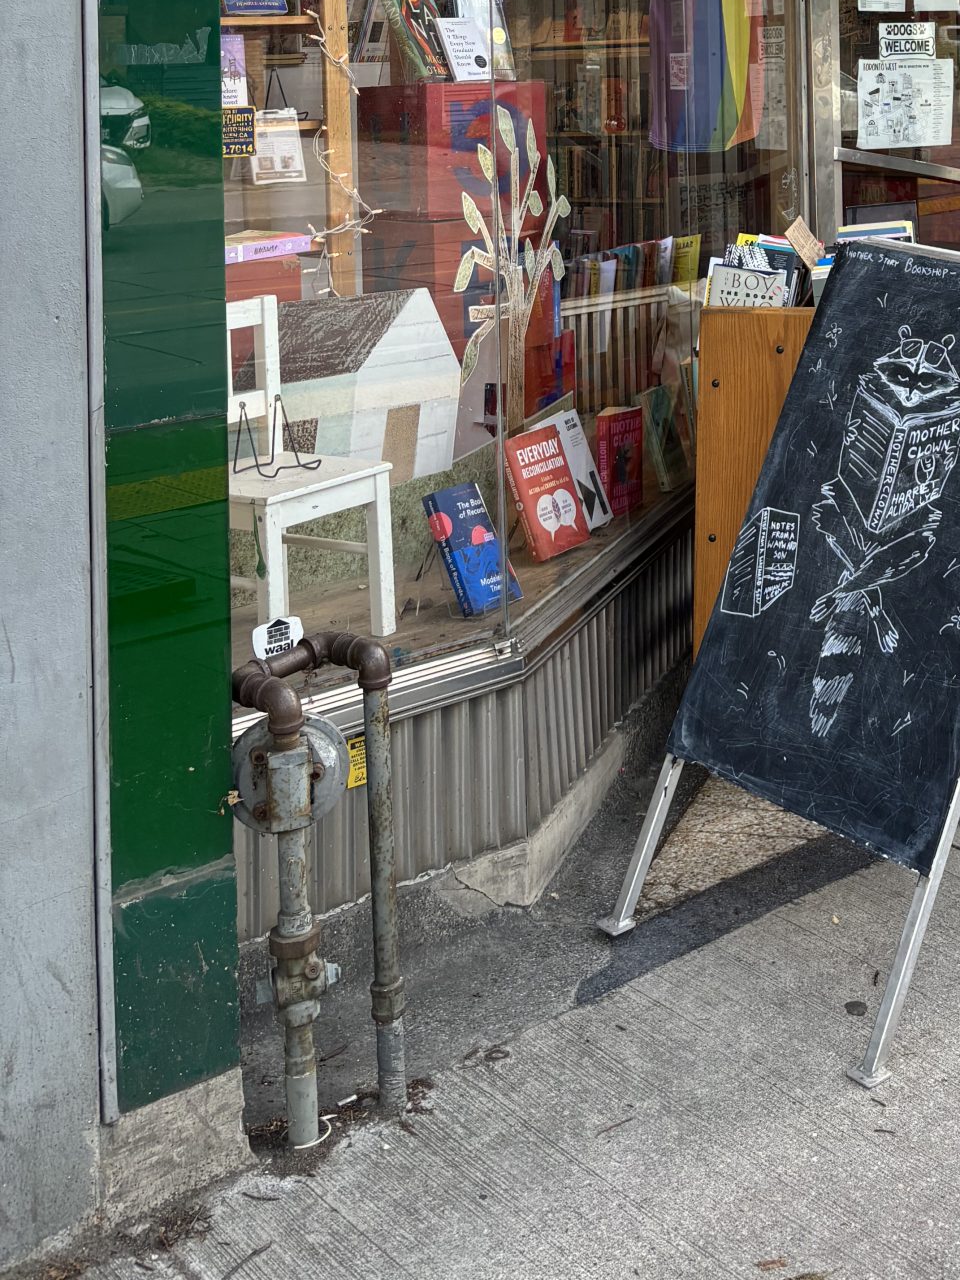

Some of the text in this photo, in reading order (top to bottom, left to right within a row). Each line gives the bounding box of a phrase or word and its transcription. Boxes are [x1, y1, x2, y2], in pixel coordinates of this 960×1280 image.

[893, 24, 918, 37] DOGS
[884, 40, 930, 53] WELCOME
[863, 62, 885, 72] TORONTO
[222, 113, 253, 124] ECURITY
[845, 248, 873, 262] ANOTHER
[878, 253, 899, 271] STORY
[904, 258, 949, 279] BOOKSHOP
[731, 272, 776, 296] BOY
[746, 293, 774, 301] BOOK
[908, 417, 960, 445] MOTHER
[516, 437, 560, 467] EVERYDAY
[907, 439, 951, 459] CLOWN
[521, 455, 565, 480] RECONCILIATION
[891, 478, 940, 505] HARRIET
[457, 501, 469, 510] The
[886, 487, 940, 519] ALIDA LYE
[467, 506, 486, 517] Recor
[770, 521, 796, 531] NOTES
[771, 531, 789, 540] FROM
[443, 548, 453, 564] Book
[773, 551, 787, 560] SON
[265, 639, 294, 656] waal
